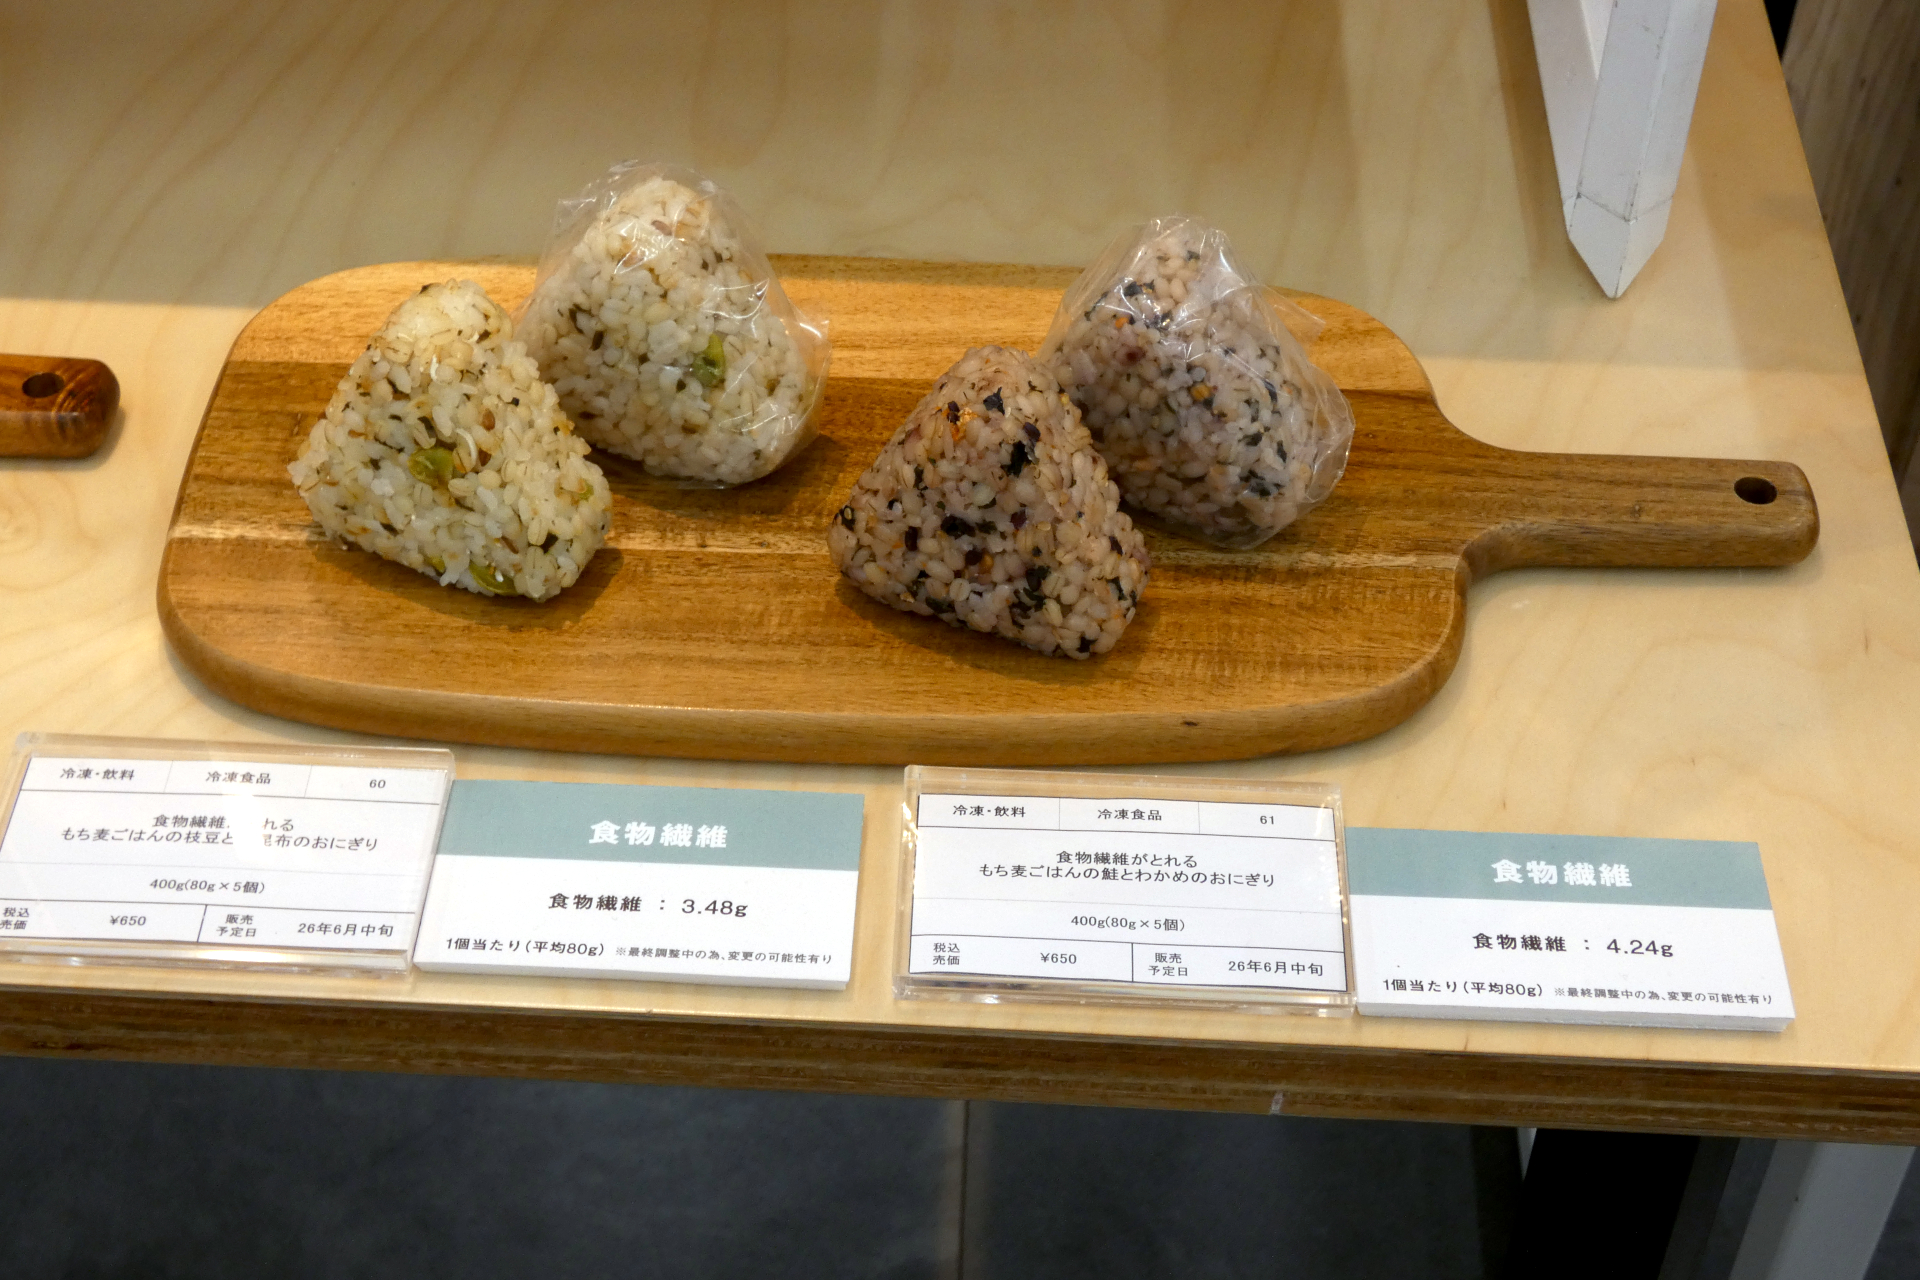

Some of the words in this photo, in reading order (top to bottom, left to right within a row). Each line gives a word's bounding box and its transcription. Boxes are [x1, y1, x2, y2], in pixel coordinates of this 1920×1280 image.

[59, 767, 135, 781] 冷凍・飲料
[205, 771, 271, 785] 冷凍食品
[368, 779, 387, 789] 60
[952, 804, 1026, 818] 冷凍・飲料
[1097, 808, 1162, 822] 冷凍食品
[1259, 815, 1275, 825] 61
[588, 819, 729, 849] 食物繊維
[1055, 850, 1198, 869] 食物繊維がとれる
[979, 862, 1275, 888] もち麦ごはんの鮭とわかめのおにぎり
[1490, 858, 1634, 888] 食物繊維
[2, 906, 30, 918] 税込
[547, 892, 643, 913] 食物繊維
[681, 898, 749, 919] 3.48g
[0, 919, 28, 930] 売価
[109, 915, 147, 927] ¥650
[225, 914, 254, 926] 販売
[216, 926, 257, 938] 予定日
[297, 922, 394, 938] 26年6月中旬
[932, 942, 961, 954] 税込
[1471, 932, 1568, 953] 食物繊維
[1605, 938, 1675, 959] 4.24g
[932, 955, 961, 967] 売価
[1039, 952, 1078, 965] ¥650
[1153, 952, 1183, 964] 販売
[1147, 965, 1189, 977] 予定日
[1228, 959, 1324, 977] 26年6月中旬
